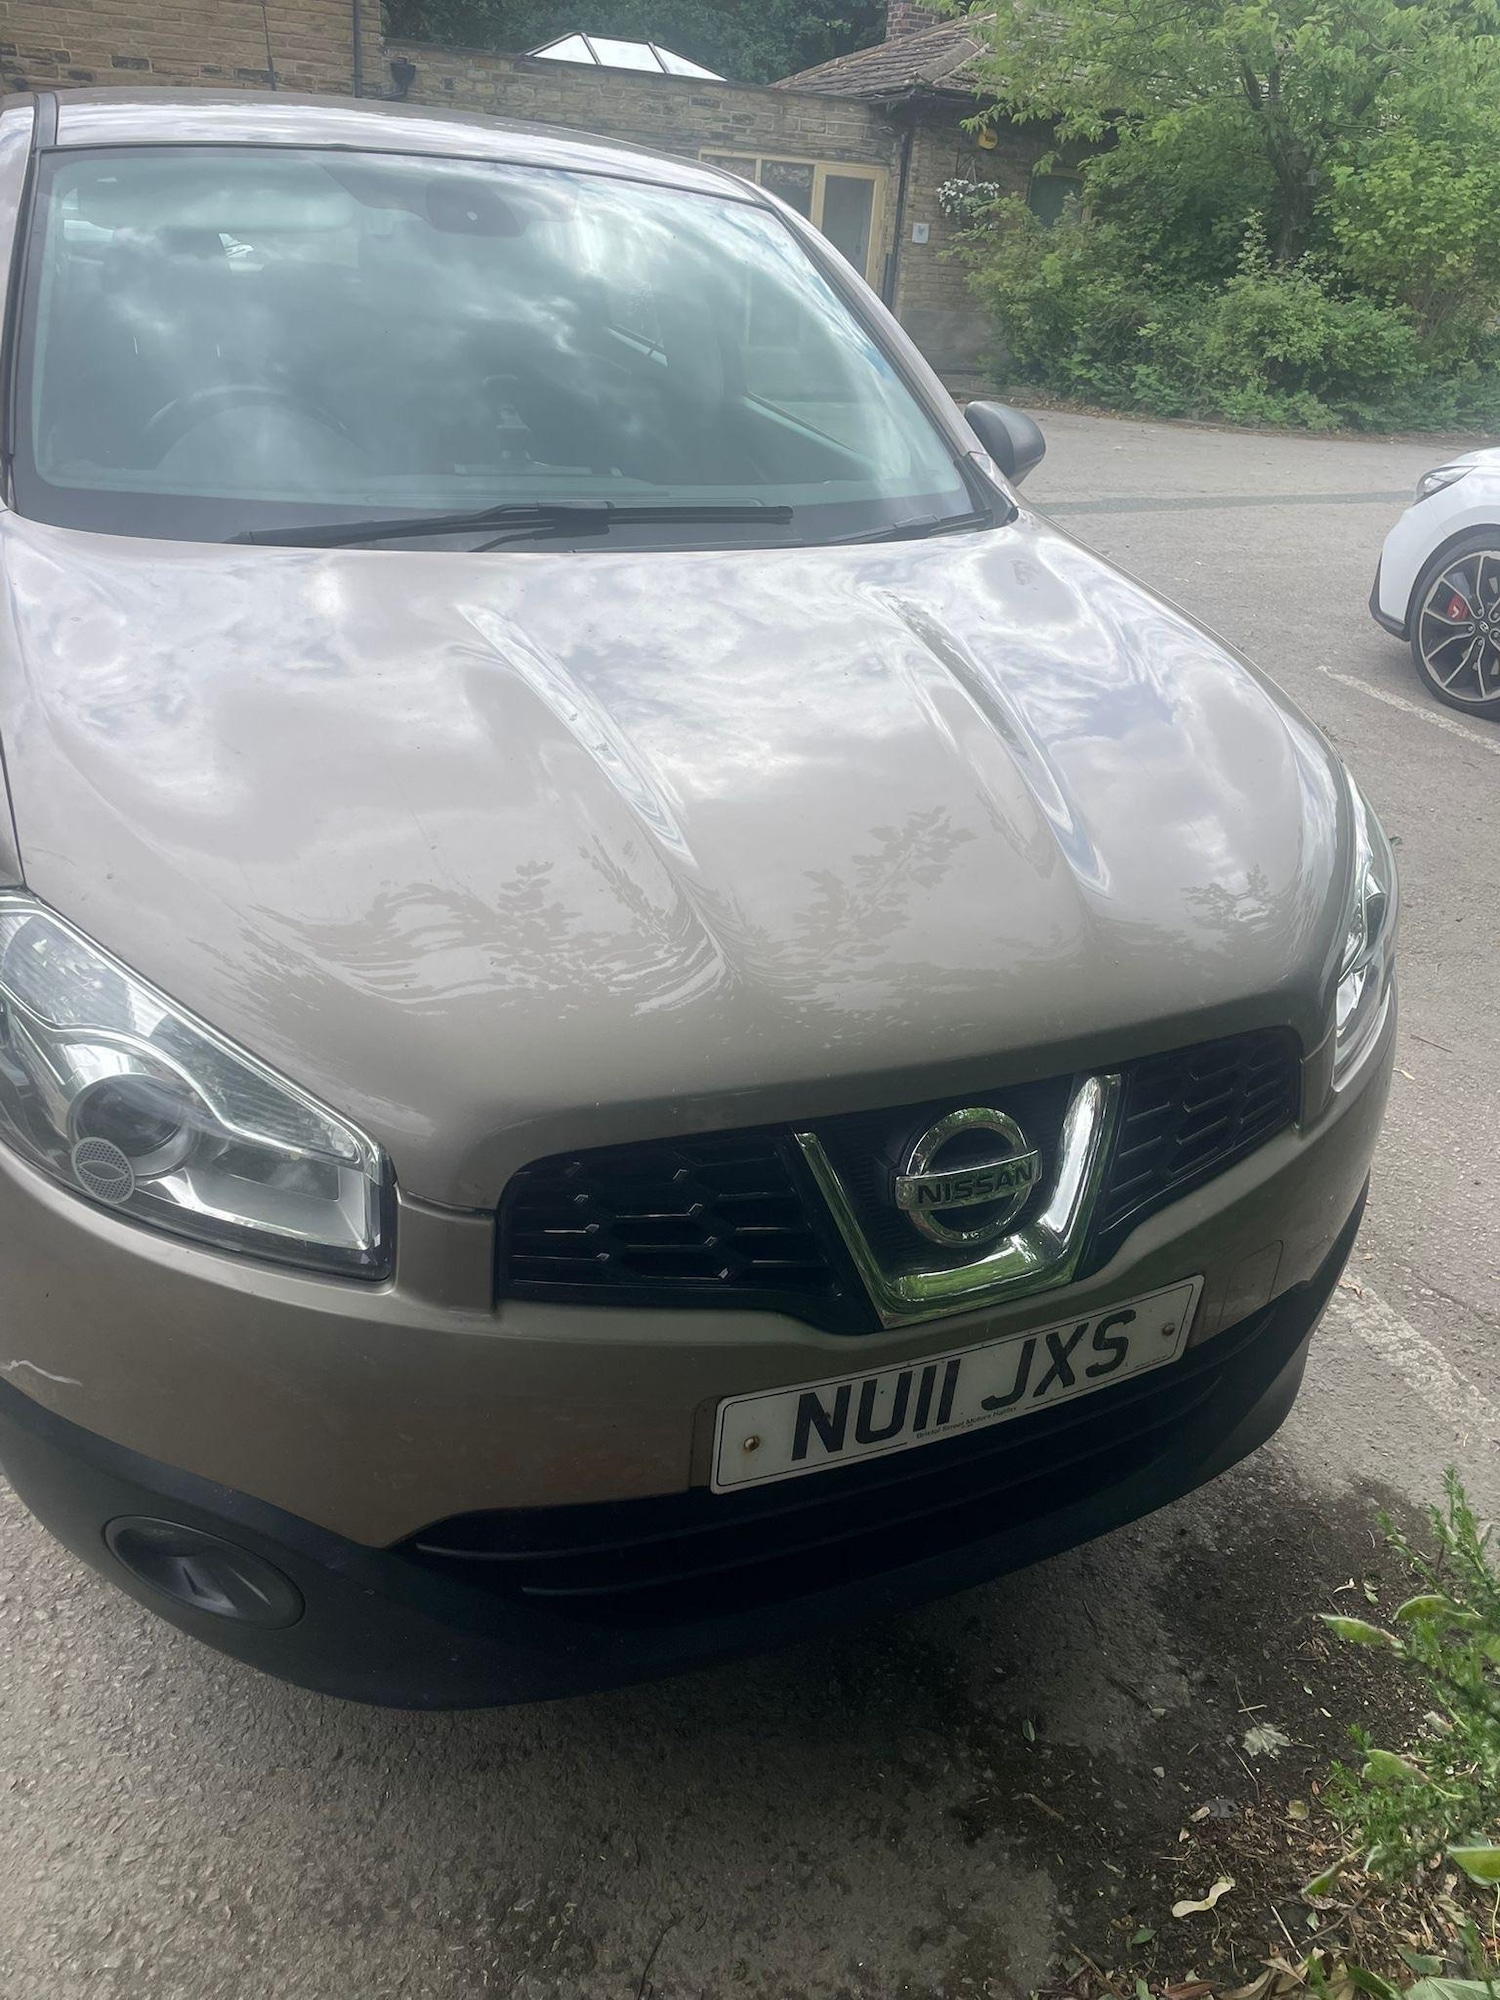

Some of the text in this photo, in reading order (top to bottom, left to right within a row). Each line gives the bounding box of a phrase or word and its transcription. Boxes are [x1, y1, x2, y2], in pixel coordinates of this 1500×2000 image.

[917, 1165, 1032, 1204] NISSAN
[791, 1309, 1137, 1461] NU11 JXS
